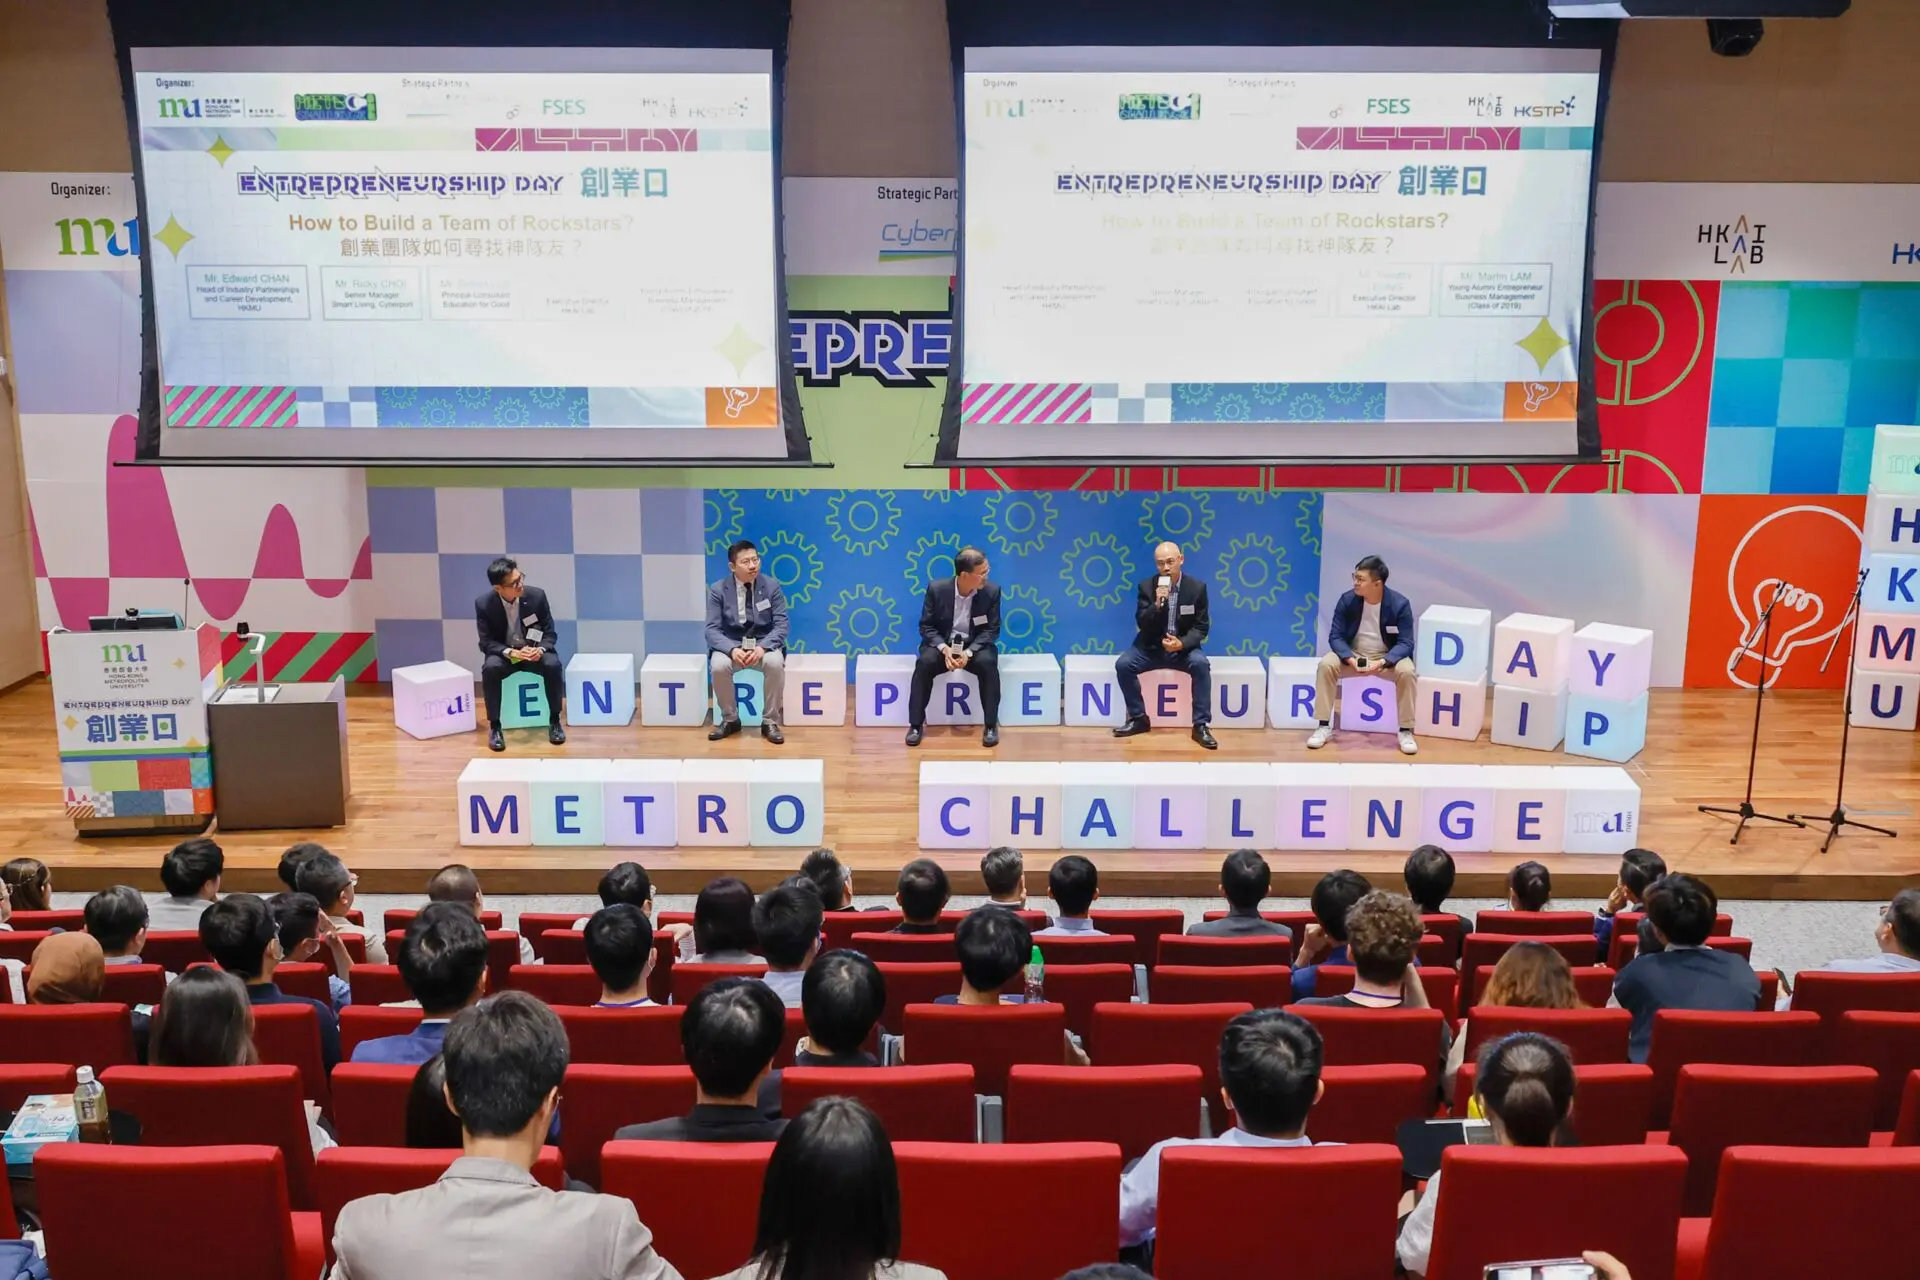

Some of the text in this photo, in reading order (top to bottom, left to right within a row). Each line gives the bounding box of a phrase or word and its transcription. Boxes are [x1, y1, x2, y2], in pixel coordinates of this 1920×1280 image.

[542, 100, 586, 115] FSES
[1366, 99, 1411, 115] FSES
[1514, 106, 1565, 118] HKSTP
[239, 171, 564, 199] ENTREPRENEURSHIP DAY
[1056, 170, 1385, 197] ENTREPRENEURSHIP DAY
[1398, 165, 1487, 196] 創業日
[51, 182, 110, 198] Organizer:
[877, 186, 932, 203] Strategic
[289, 214, 634, 231] How to Build a Team of Rockstars?
[1336, 212, 1449, 230] Rockstars?
[204, 273, 290, 283] Mr. Edward CHAN
[1510, 272, 1532, 281] LAM
[1488, 293, 1536, 302] Management
[1434, 631, 1616, 687] DAY
[171, 698, 192, 706] DAY
[85, 713, 178, 742] 創業日
[469, 795, 805, 834] METRO
[940, 796, 1543, 841] CHALLENGE
